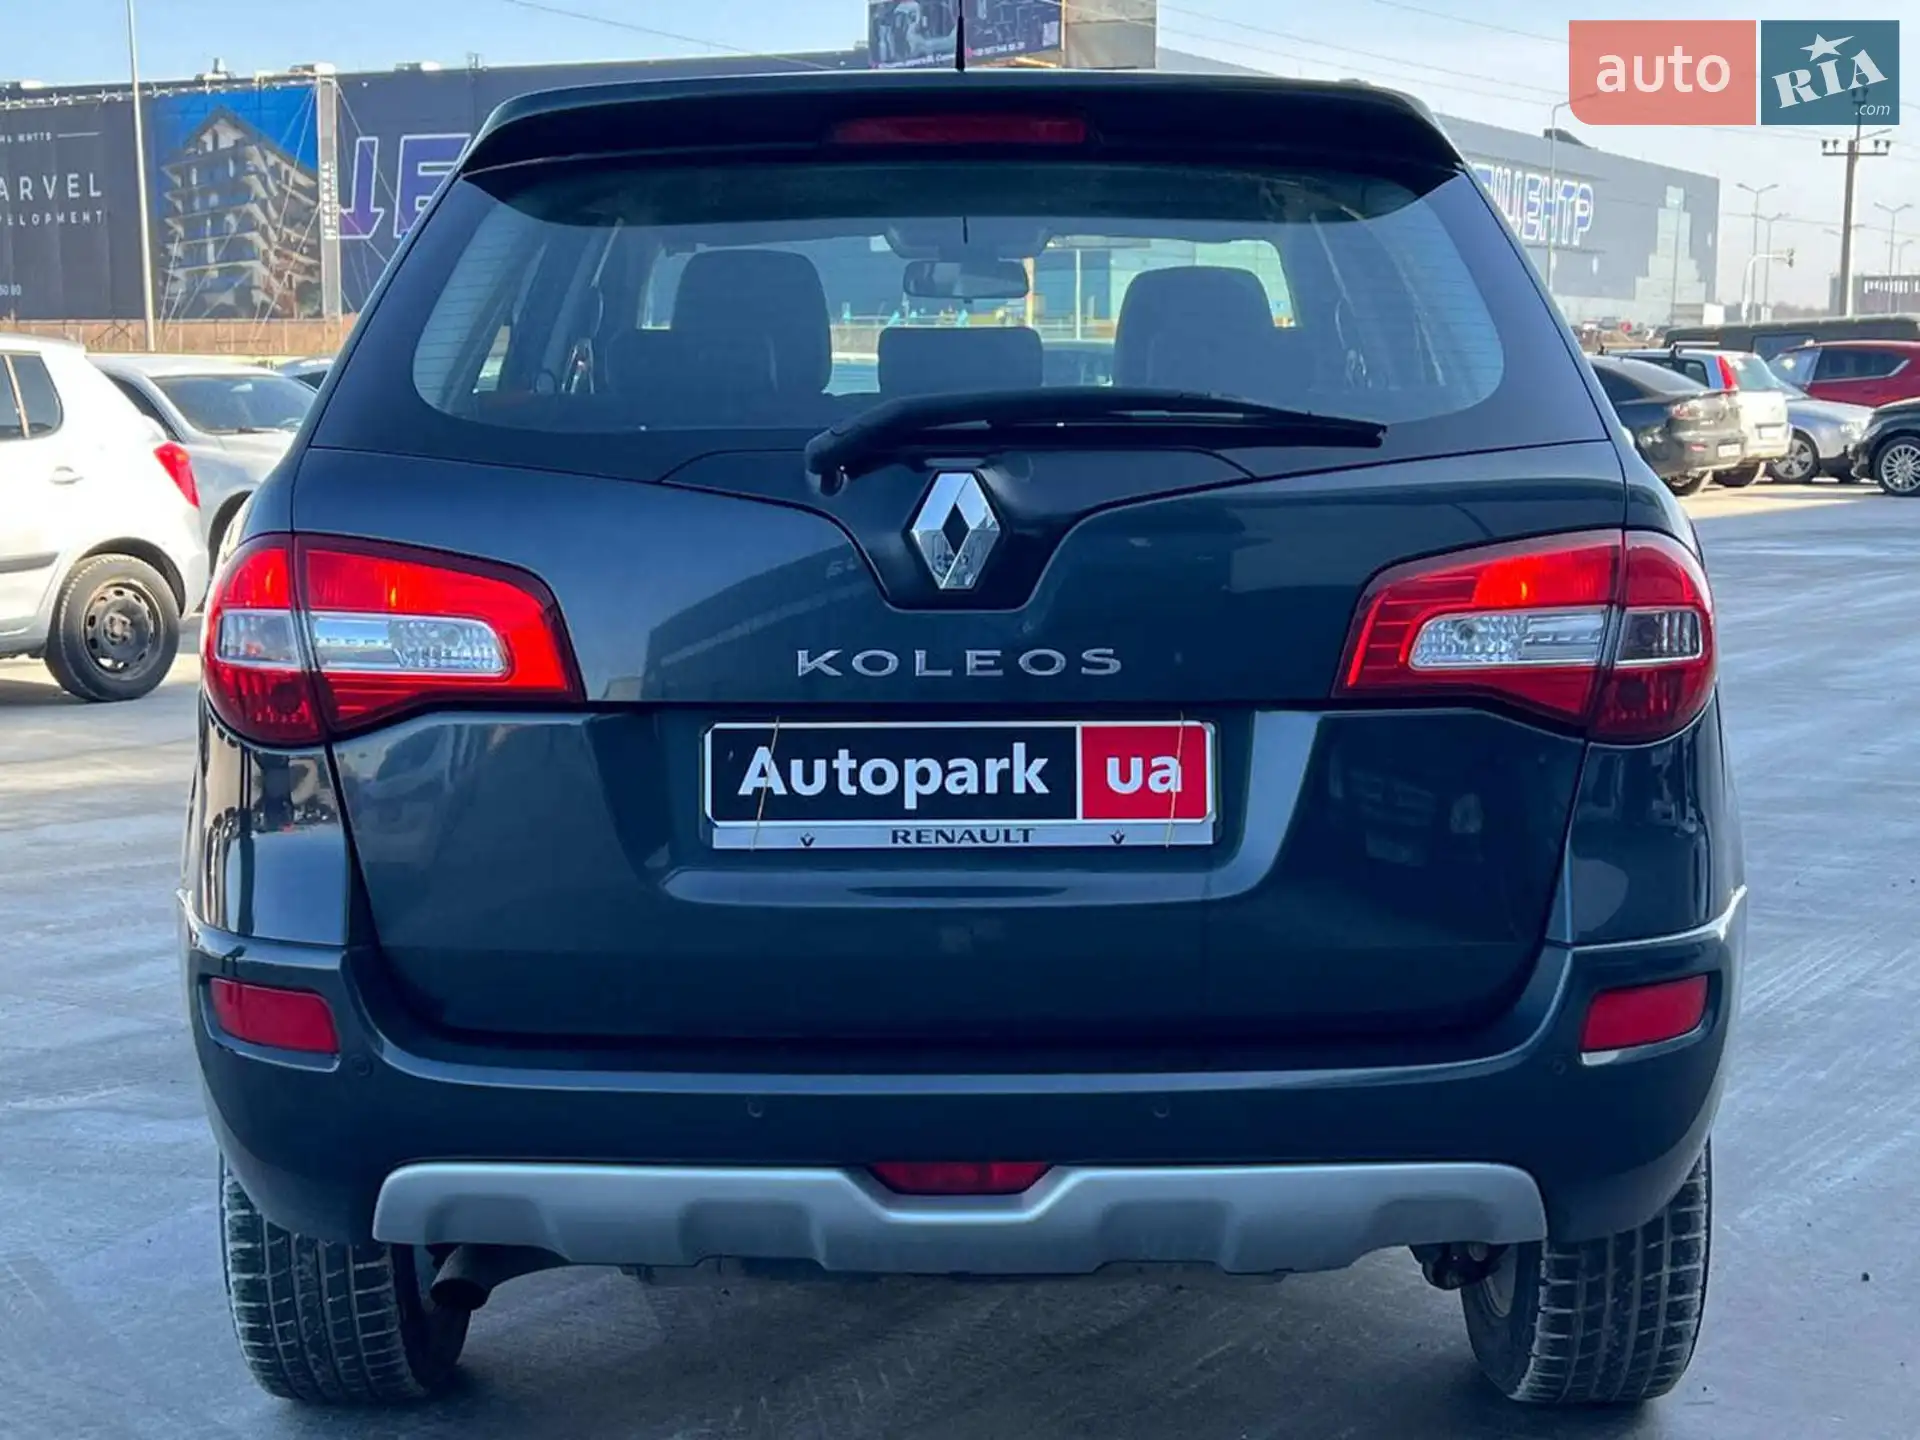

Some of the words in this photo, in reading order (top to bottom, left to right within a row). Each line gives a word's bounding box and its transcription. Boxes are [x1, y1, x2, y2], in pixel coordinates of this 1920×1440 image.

[0, 209, 103, 227] ELOPMENT
[797, 648, 1123, 677] KOLEOS
[737, 742, 1050, 810] Autopark
[1105, 755, 1183, 794] ua
[890, 827, 1036, 845] RENAULT
